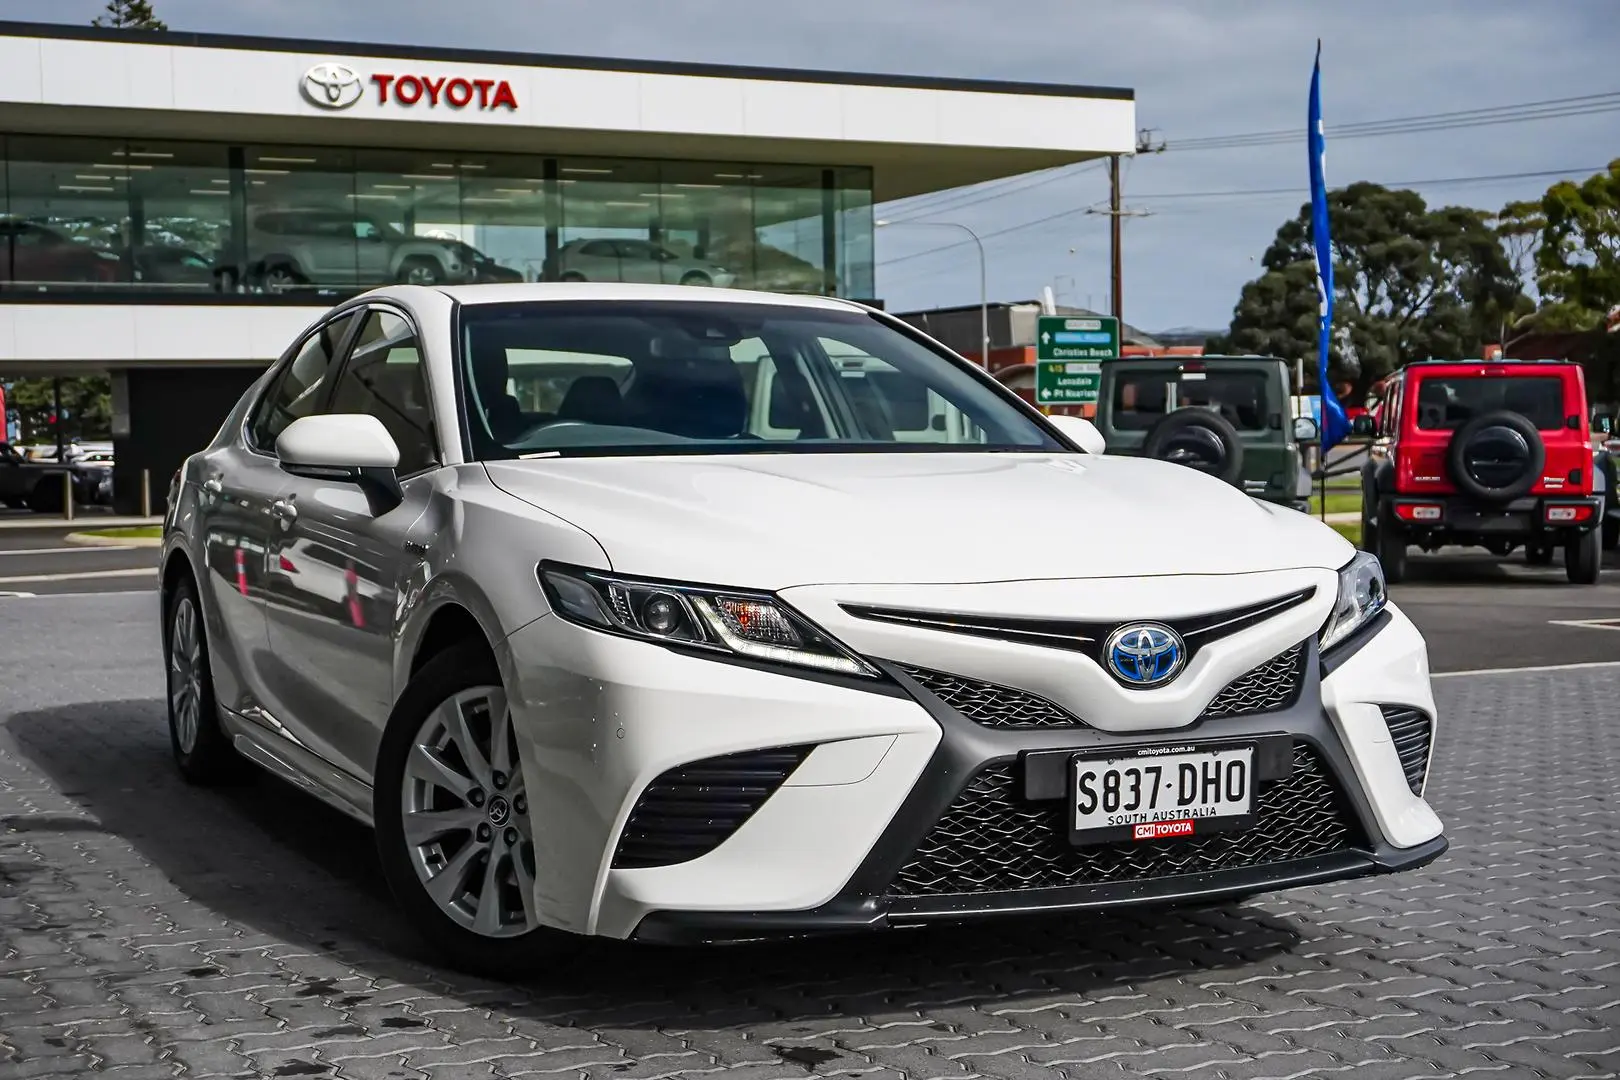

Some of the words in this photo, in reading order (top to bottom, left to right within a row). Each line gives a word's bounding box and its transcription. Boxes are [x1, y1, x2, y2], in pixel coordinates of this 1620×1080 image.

[371, 74, 518, 109] TOYOTA
[1053, 348, 1088, 356] Christies
[1090, 348, 1112, 356] Beach
[1053, 389, 1064, 398] Pt
[1137, 745, 1196, 756] cmitoyota.com.au
[1107, 813, 1147, 826] SOUTH
[1152, 806, 1217, 822] AUSTRALIA
[1136, 825, 1155, 838] CMI
[1156, 823, 1192, 835] TOYOTA
